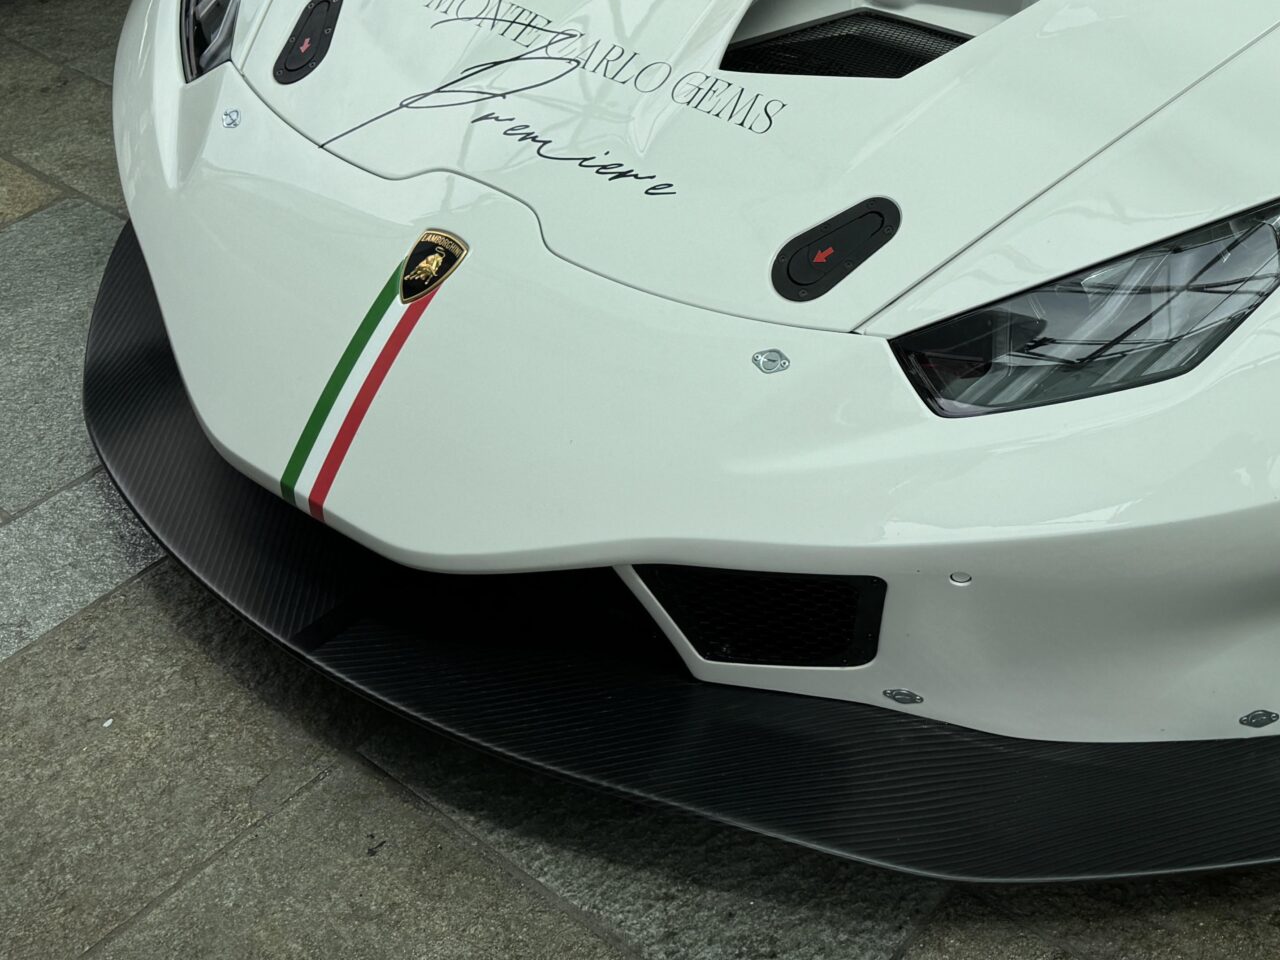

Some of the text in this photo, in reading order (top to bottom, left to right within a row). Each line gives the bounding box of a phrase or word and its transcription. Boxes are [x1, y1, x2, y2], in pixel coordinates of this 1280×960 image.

[545, 29, 673, 94] CARLO
[670, 70, 788, 135] GEMS
[421, 233, 463, 257] LAMBORGHINI
